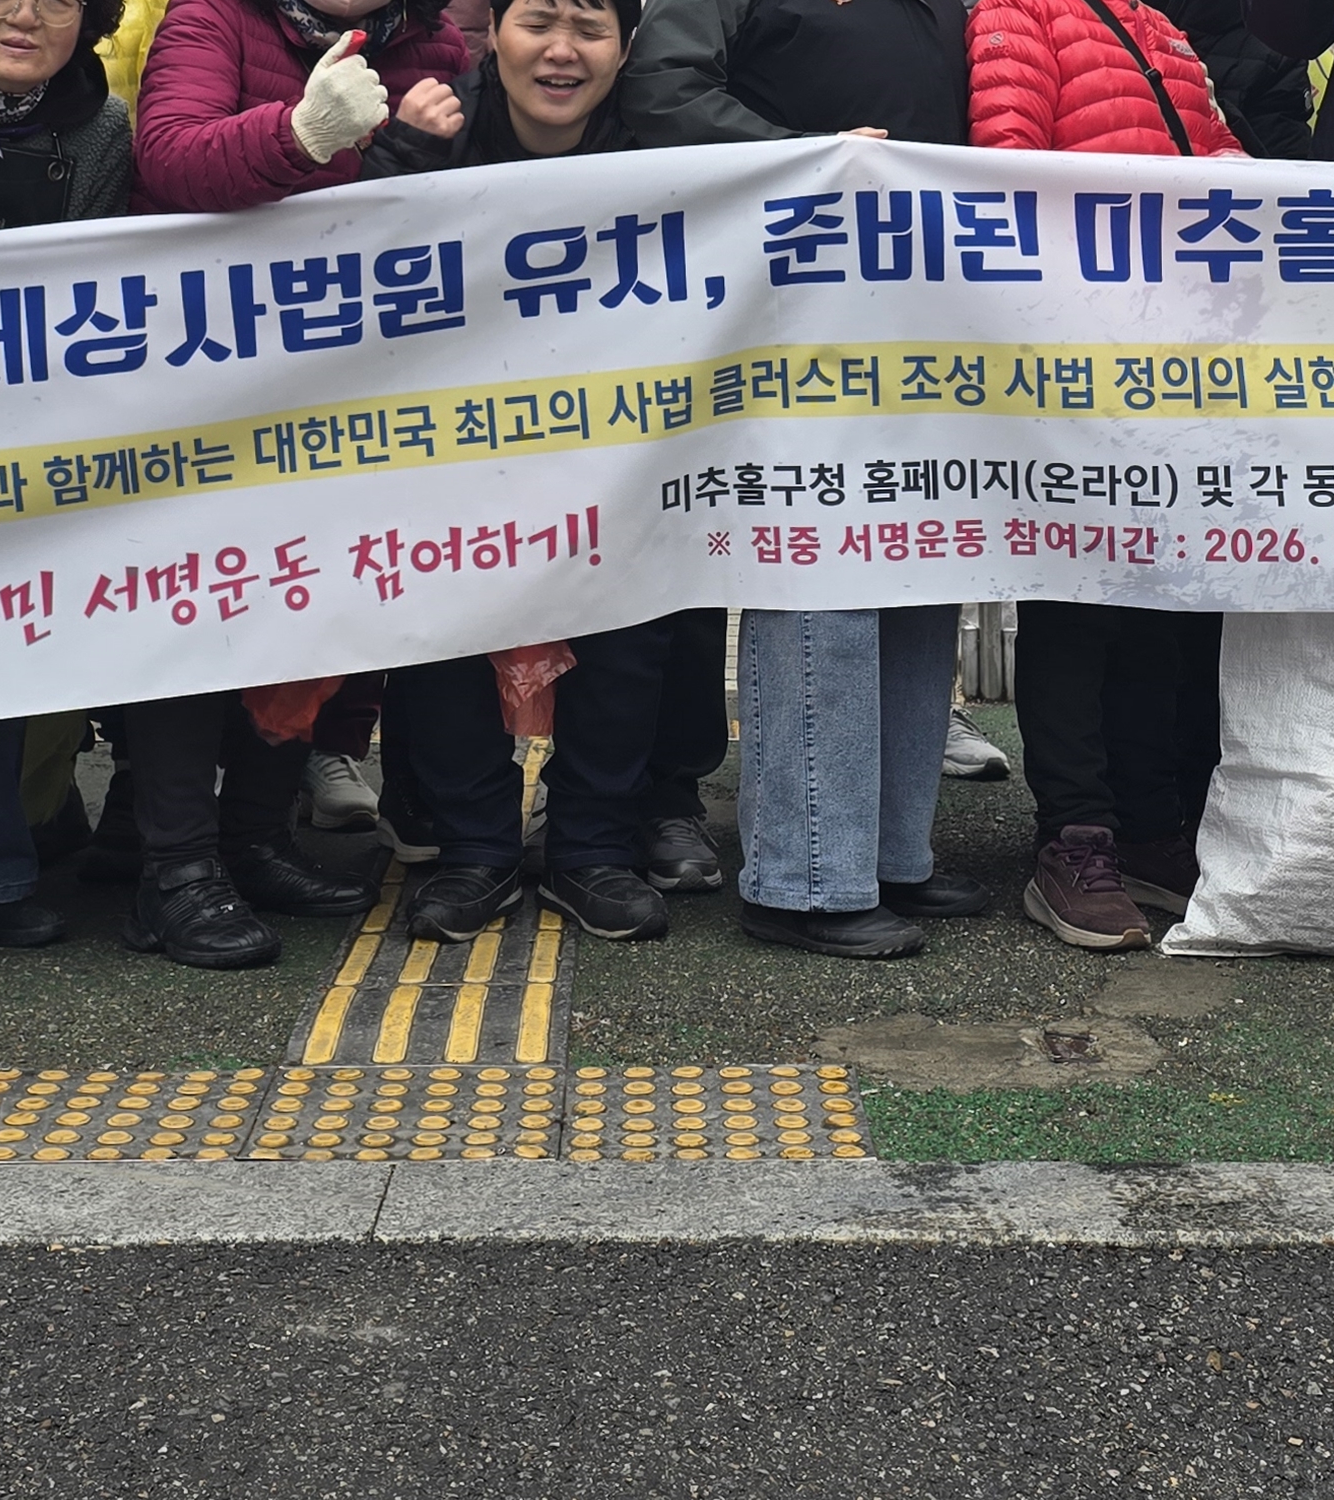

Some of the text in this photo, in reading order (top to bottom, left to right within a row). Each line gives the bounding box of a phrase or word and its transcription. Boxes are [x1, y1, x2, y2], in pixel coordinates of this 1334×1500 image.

[503, 210, 726, 319] 유치,
[762, 189, 1043, 287] 준비된
[43, 437, 236, 502] 함께하는
[252, 404, 438, 475] 대한민국
[454, 388, 589, 453] 최고의
[605, 375, 695, 435] 사법
[708, 354, 881, 414] 클러스터
[900, 355, 987, 411] 조성
[1004, 356, 1096, 410] 사법
[1114, 355, 1249, 411] 정의의
[661, 461, 847, 512] 미추홀구청
[862, 458, 1179, 508] 홈페이지(온라인)
[1196, 465, 1235, 508] 및
[1249, 464, 1288, 507] 각
[83, 535, 321, 626] 서명운동
[348, 504, 602, 603] 참여하기!
[750, 525, 821, 565] 집중
[838, 519, 988, 562] 서명운동
[1003, 518, 1159, 564] 참여기간
[1204, 528, 1320, 565] 2026.
